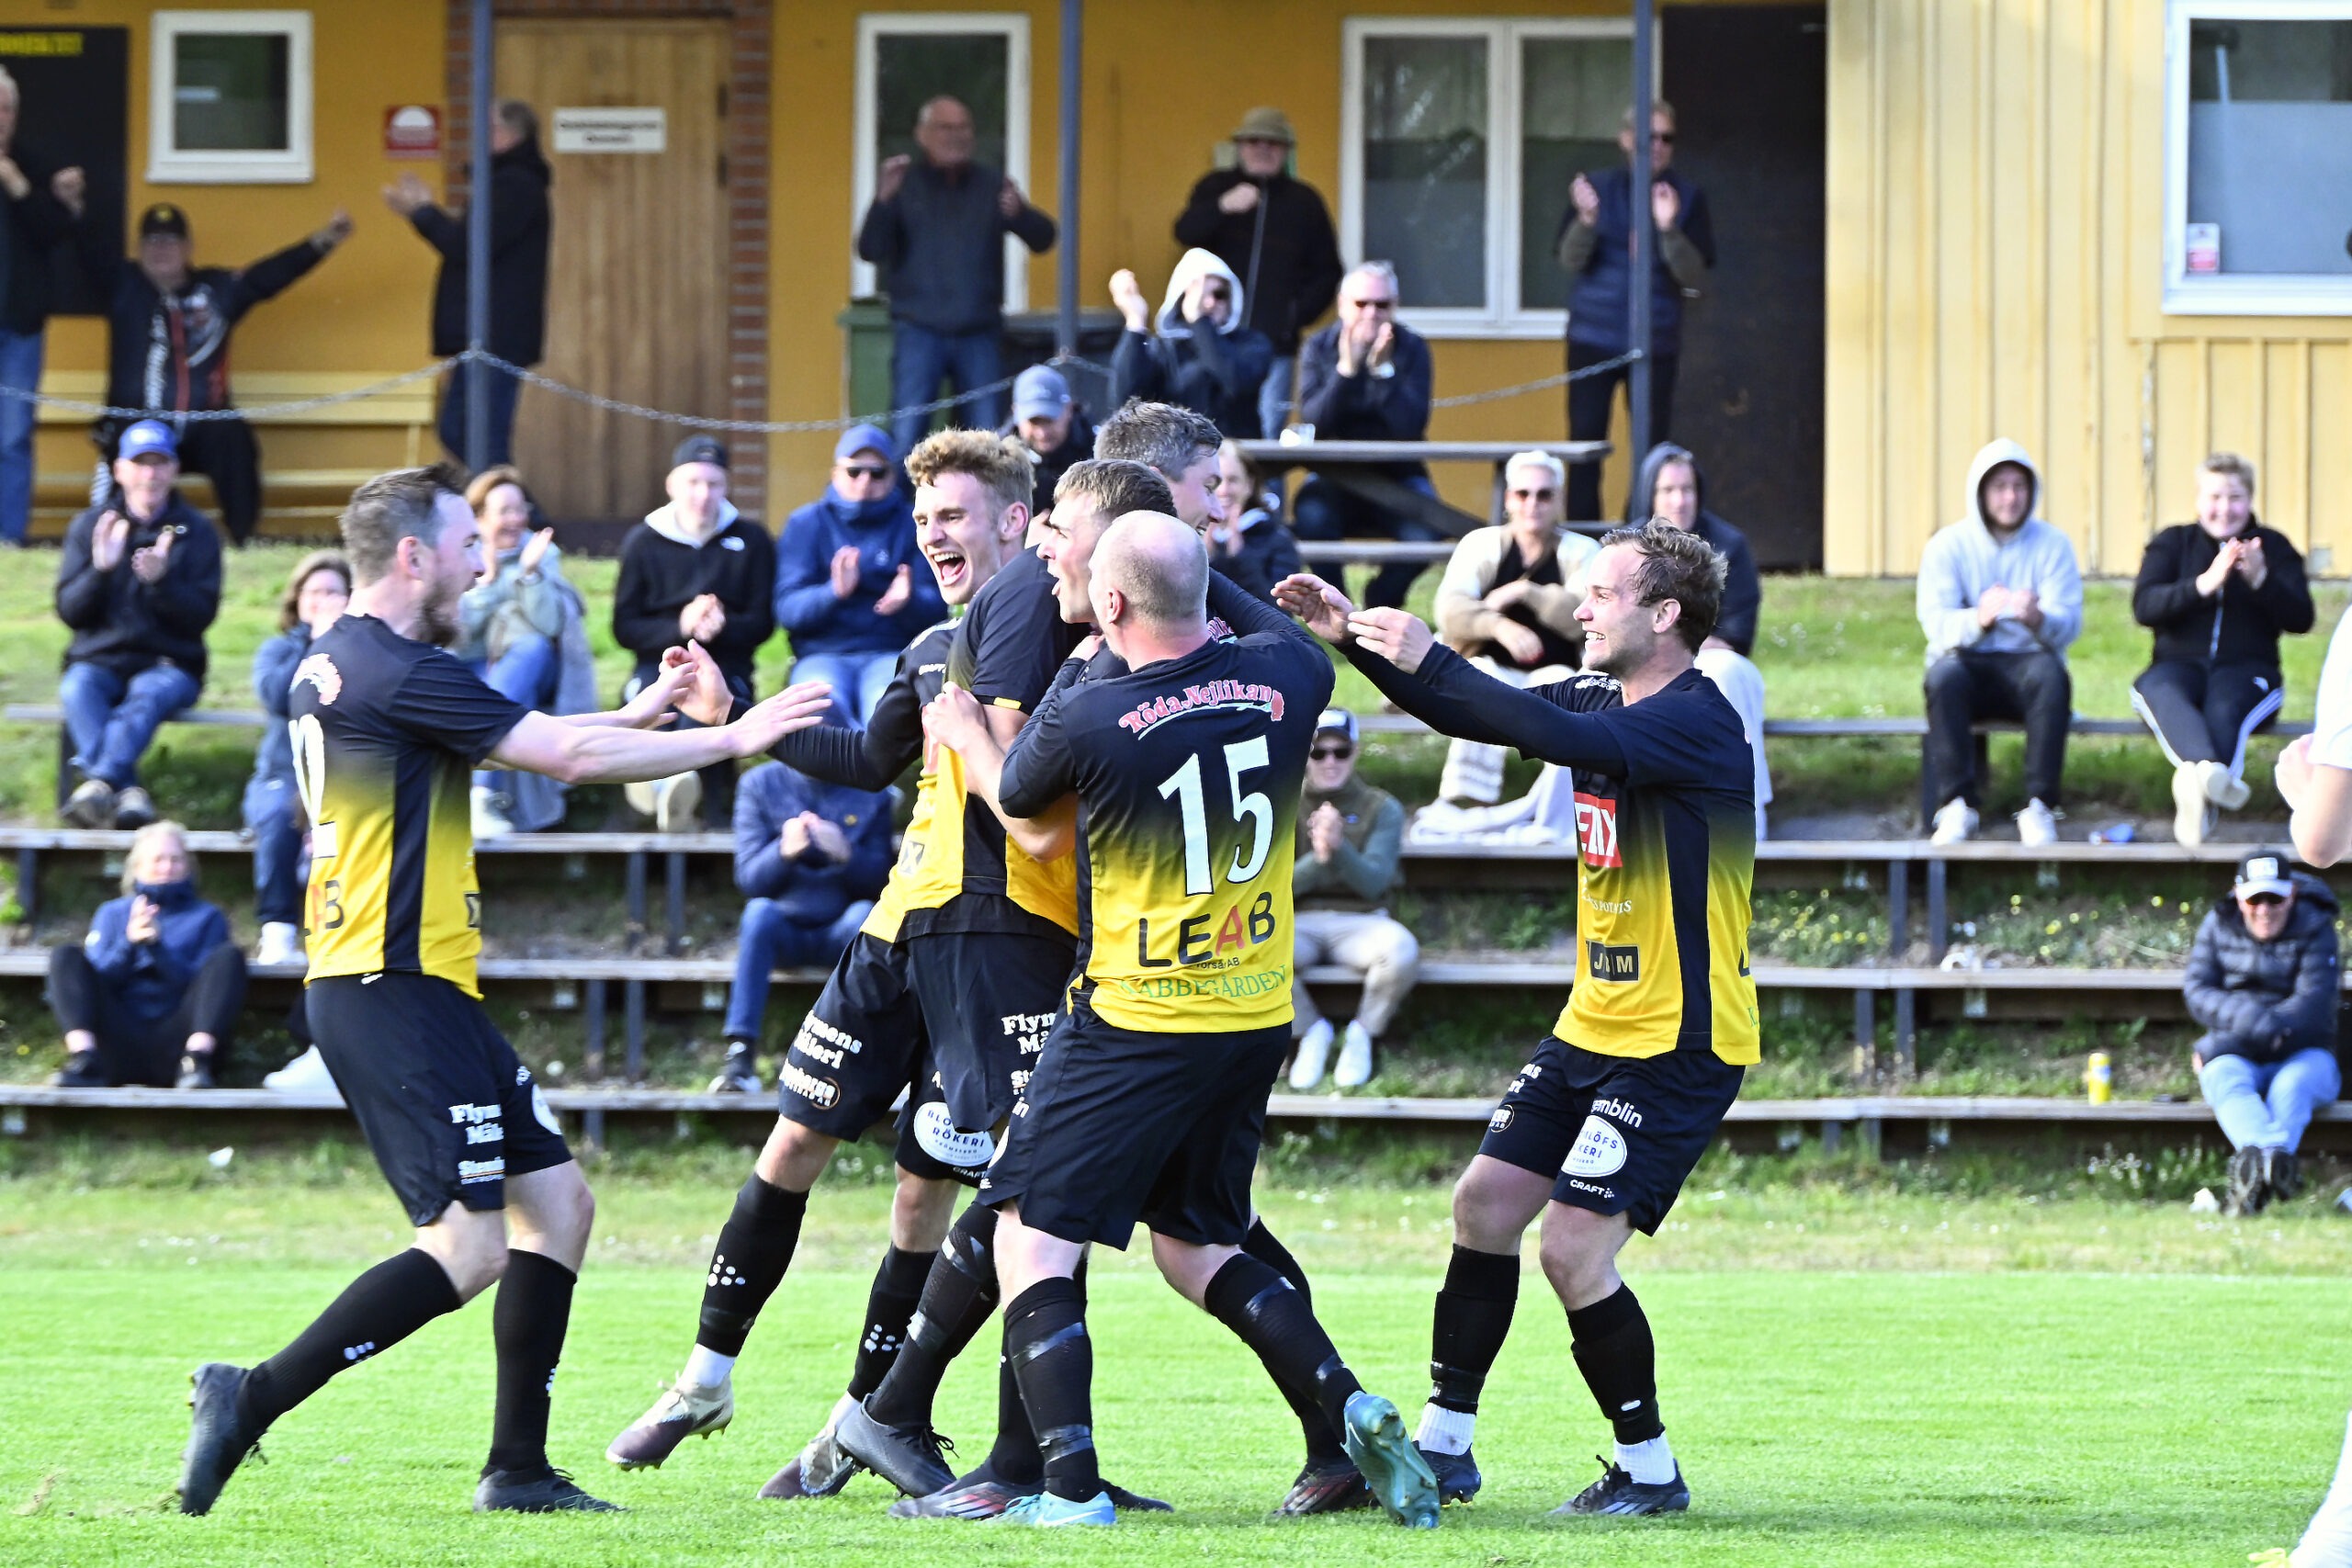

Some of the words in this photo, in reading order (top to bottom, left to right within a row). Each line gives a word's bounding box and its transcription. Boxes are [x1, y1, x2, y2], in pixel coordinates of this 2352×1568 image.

[1118, 695, 1182, 734] Röda
[1182, 679, 1272, 709] Nejlikan
[1158, 735, 1273, 897] 15
[1138, 891, 1276, 967] LEAB
[1227, 956, 1240, 967] AB
[933, 1126, 985, 1147] RÖKERI
[1569, 1179, 1605, 1195] CRAFT
